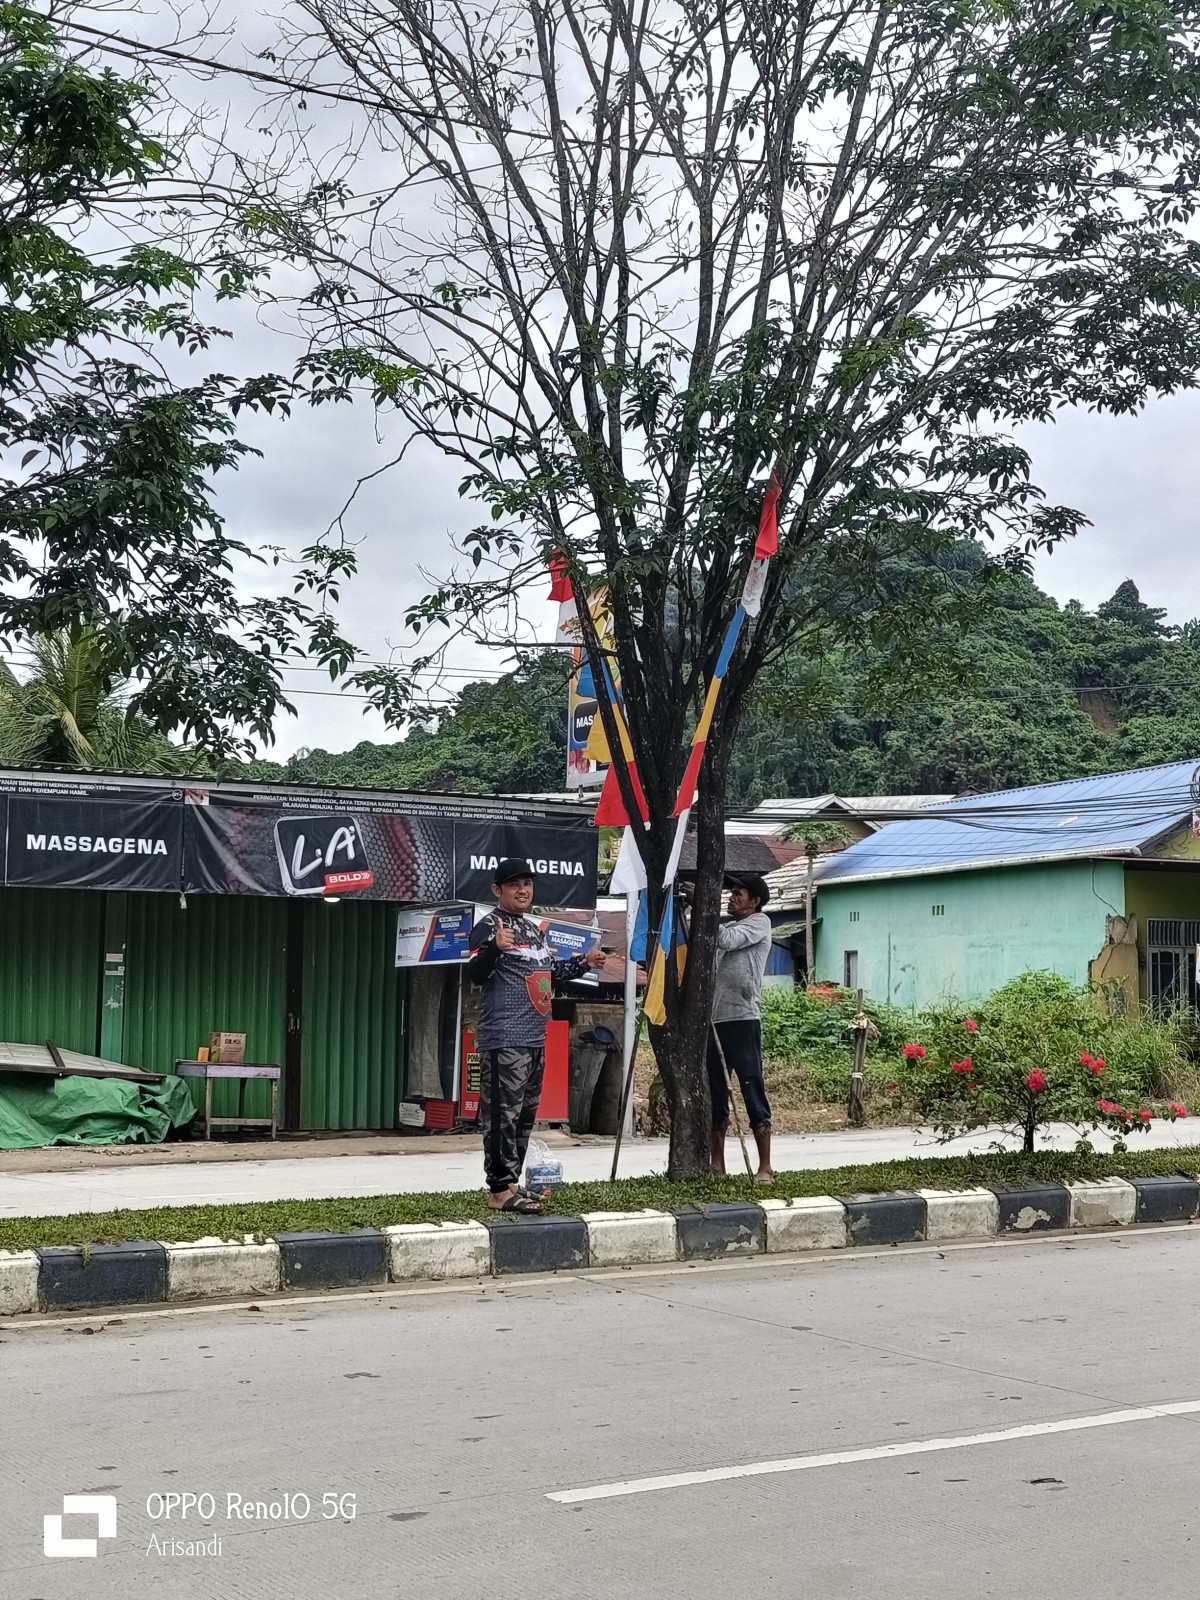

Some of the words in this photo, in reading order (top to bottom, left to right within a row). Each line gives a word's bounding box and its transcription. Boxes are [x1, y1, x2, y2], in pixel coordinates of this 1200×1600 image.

[576, 715, 594, 728] MAS
[26, 833, 168, 855] MASSAGENA
[470, 855, 585, 876] MAAGENA
[329, 873, 362, 884] BOLD
[551, 936, 583, 948] MASAGENA
